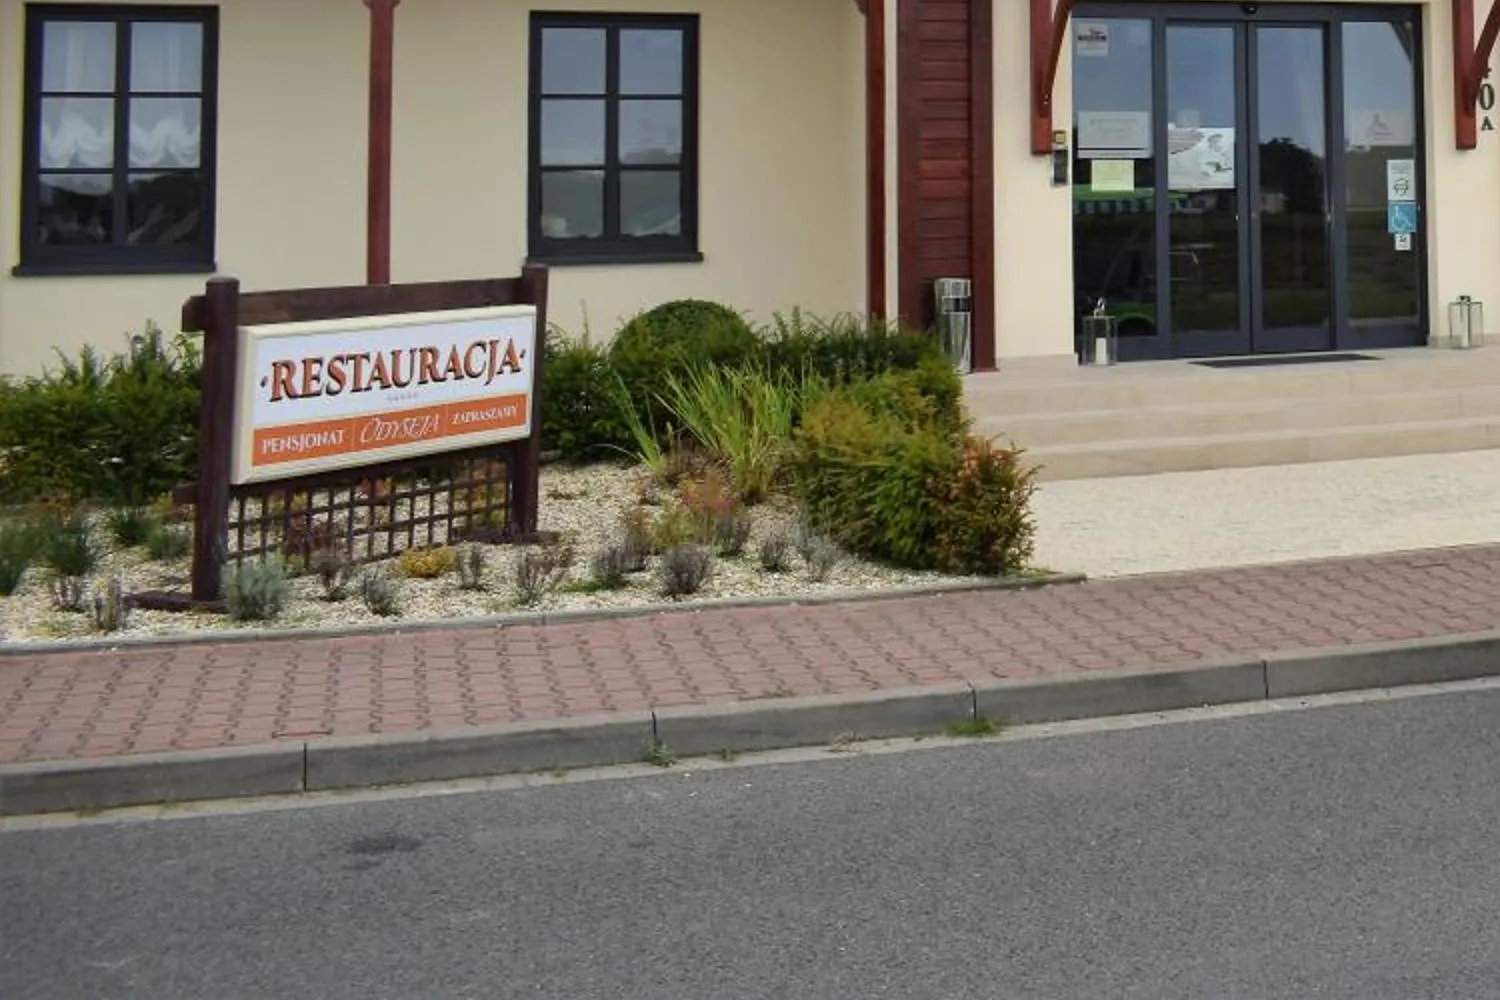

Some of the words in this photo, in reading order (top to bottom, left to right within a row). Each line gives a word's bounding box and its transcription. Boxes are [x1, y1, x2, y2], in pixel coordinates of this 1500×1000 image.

[268, 337, 521, 402] RESTAURACJA
[262, 428, 346, 455] PENSJONAT
[452, 402, 518, 425] ZAPRASZAMY
